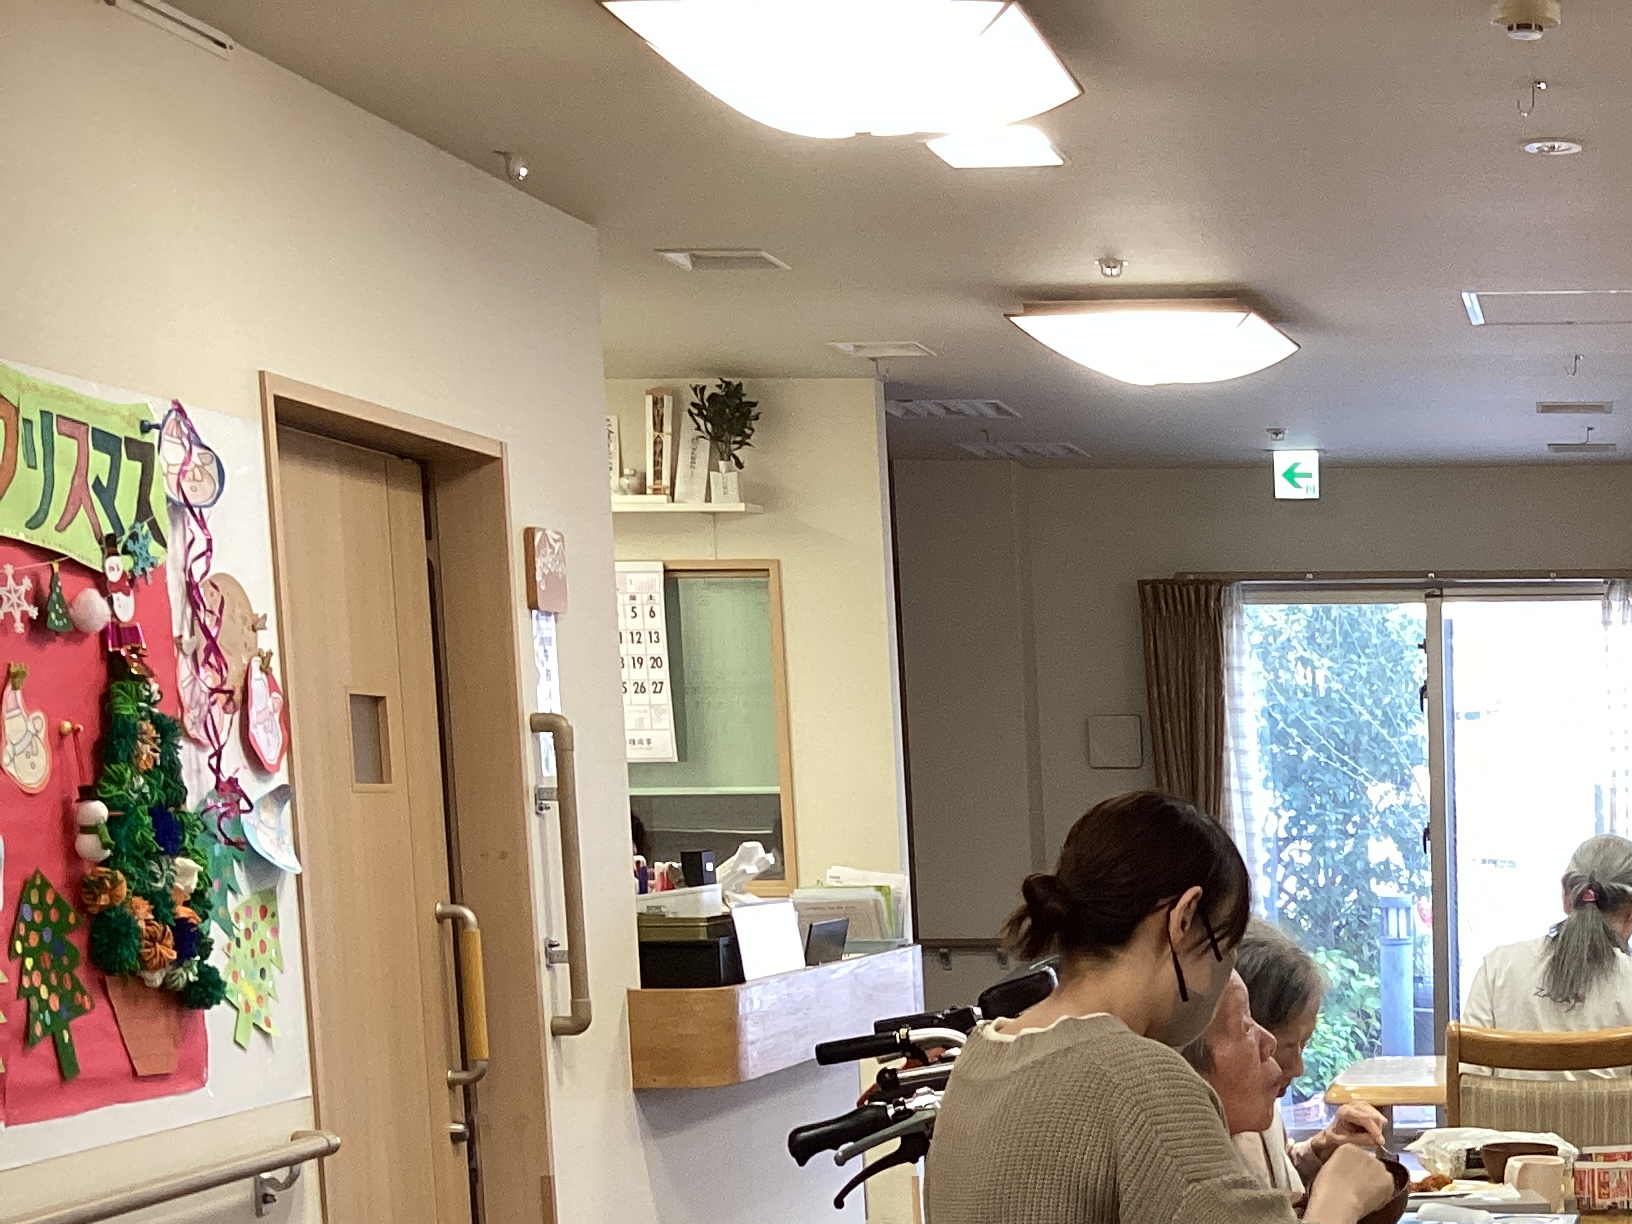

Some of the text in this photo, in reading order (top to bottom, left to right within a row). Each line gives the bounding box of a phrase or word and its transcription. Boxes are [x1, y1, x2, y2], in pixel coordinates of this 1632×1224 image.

[630, 606, 656, 619] 5 6
[629, 631, 643, 645] 12
[648, 631, 660, 645] 13
[631, 656, 644, 670] 19
[649, 656, 663, 669] 20
[632, 681, 647, 694] 26
[651, 681, 664, 694] 27
